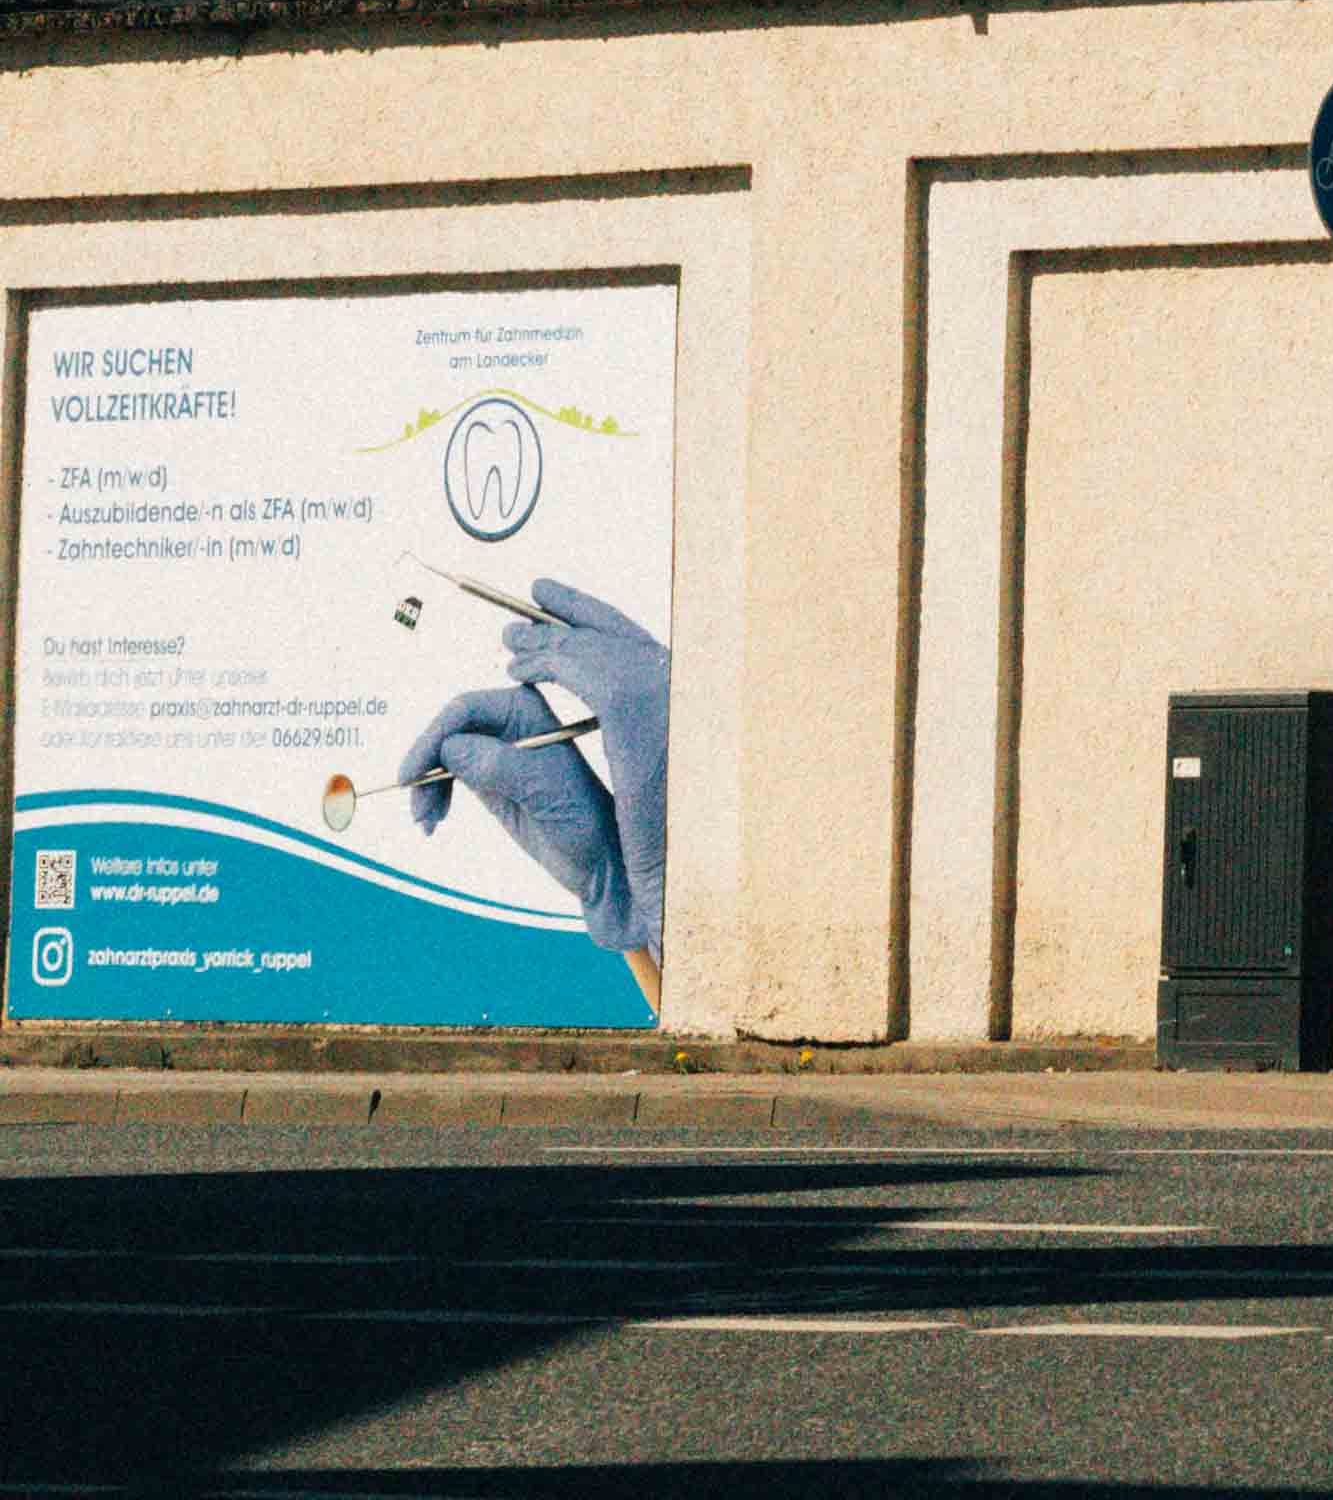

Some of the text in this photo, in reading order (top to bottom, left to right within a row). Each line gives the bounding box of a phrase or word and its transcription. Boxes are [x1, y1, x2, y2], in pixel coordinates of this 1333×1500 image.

[53, 347, 194, 379] WIR SUCHEN
[50, 383, 237, 423] VOLLZEITKRÄFTE!
[60, 465, 168, 492] ZFA (m/w/d)
[229, 500, 257, 521] als
[261, 497, 296, 521] ZFA
[300, 497, 374, 523] (m/w/d)
[229, 533, 302, 561] (m/w/d)
[43, 636, 185, 657] Du hast Interesse?
[90, 883, 220, 907] www.dr-ruppel.de
